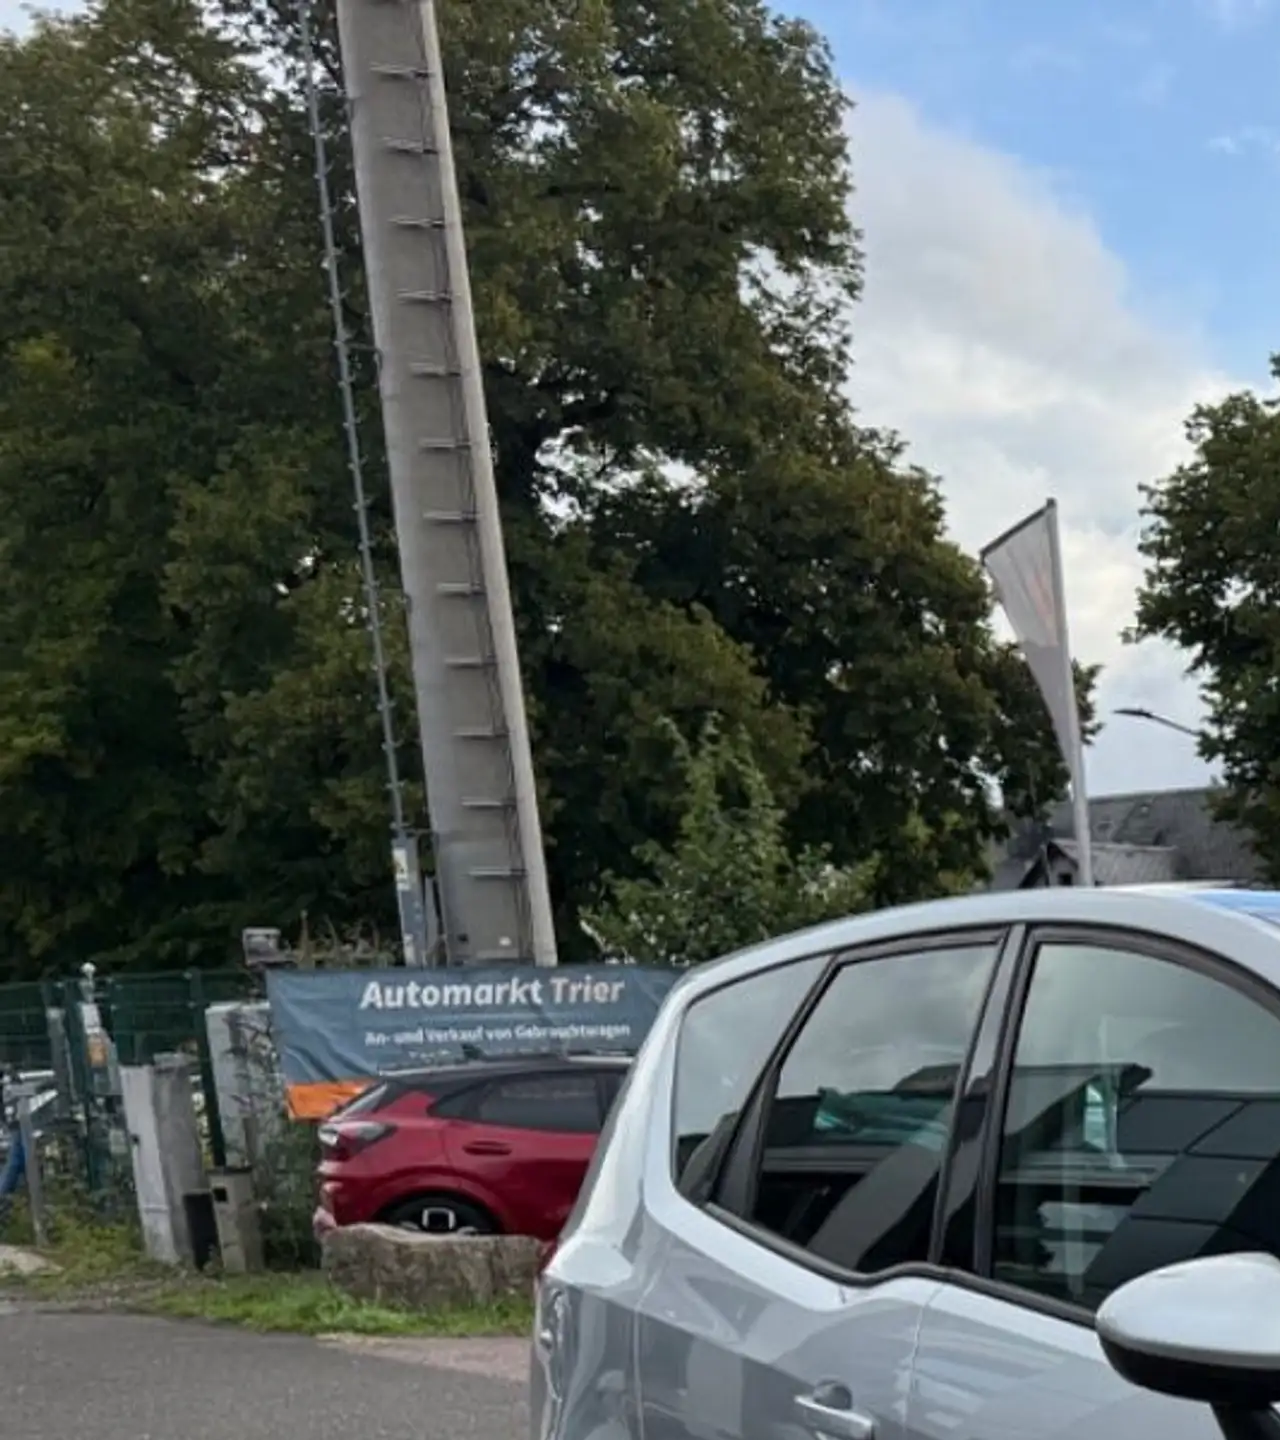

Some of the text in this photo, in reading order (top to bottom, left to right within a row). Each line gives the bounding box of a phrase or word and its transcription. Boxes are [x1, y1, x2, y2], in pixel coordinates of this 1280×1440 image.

[359, 975, 626, 1010] Automarkt Trier
[393, 1028, 423, 1045] und
[424, 1025, 484, 1044] Verkauf
[484, 1028, 512, 1041] von
[514, 1024, 631, 1041] Gebrauchtwagen
